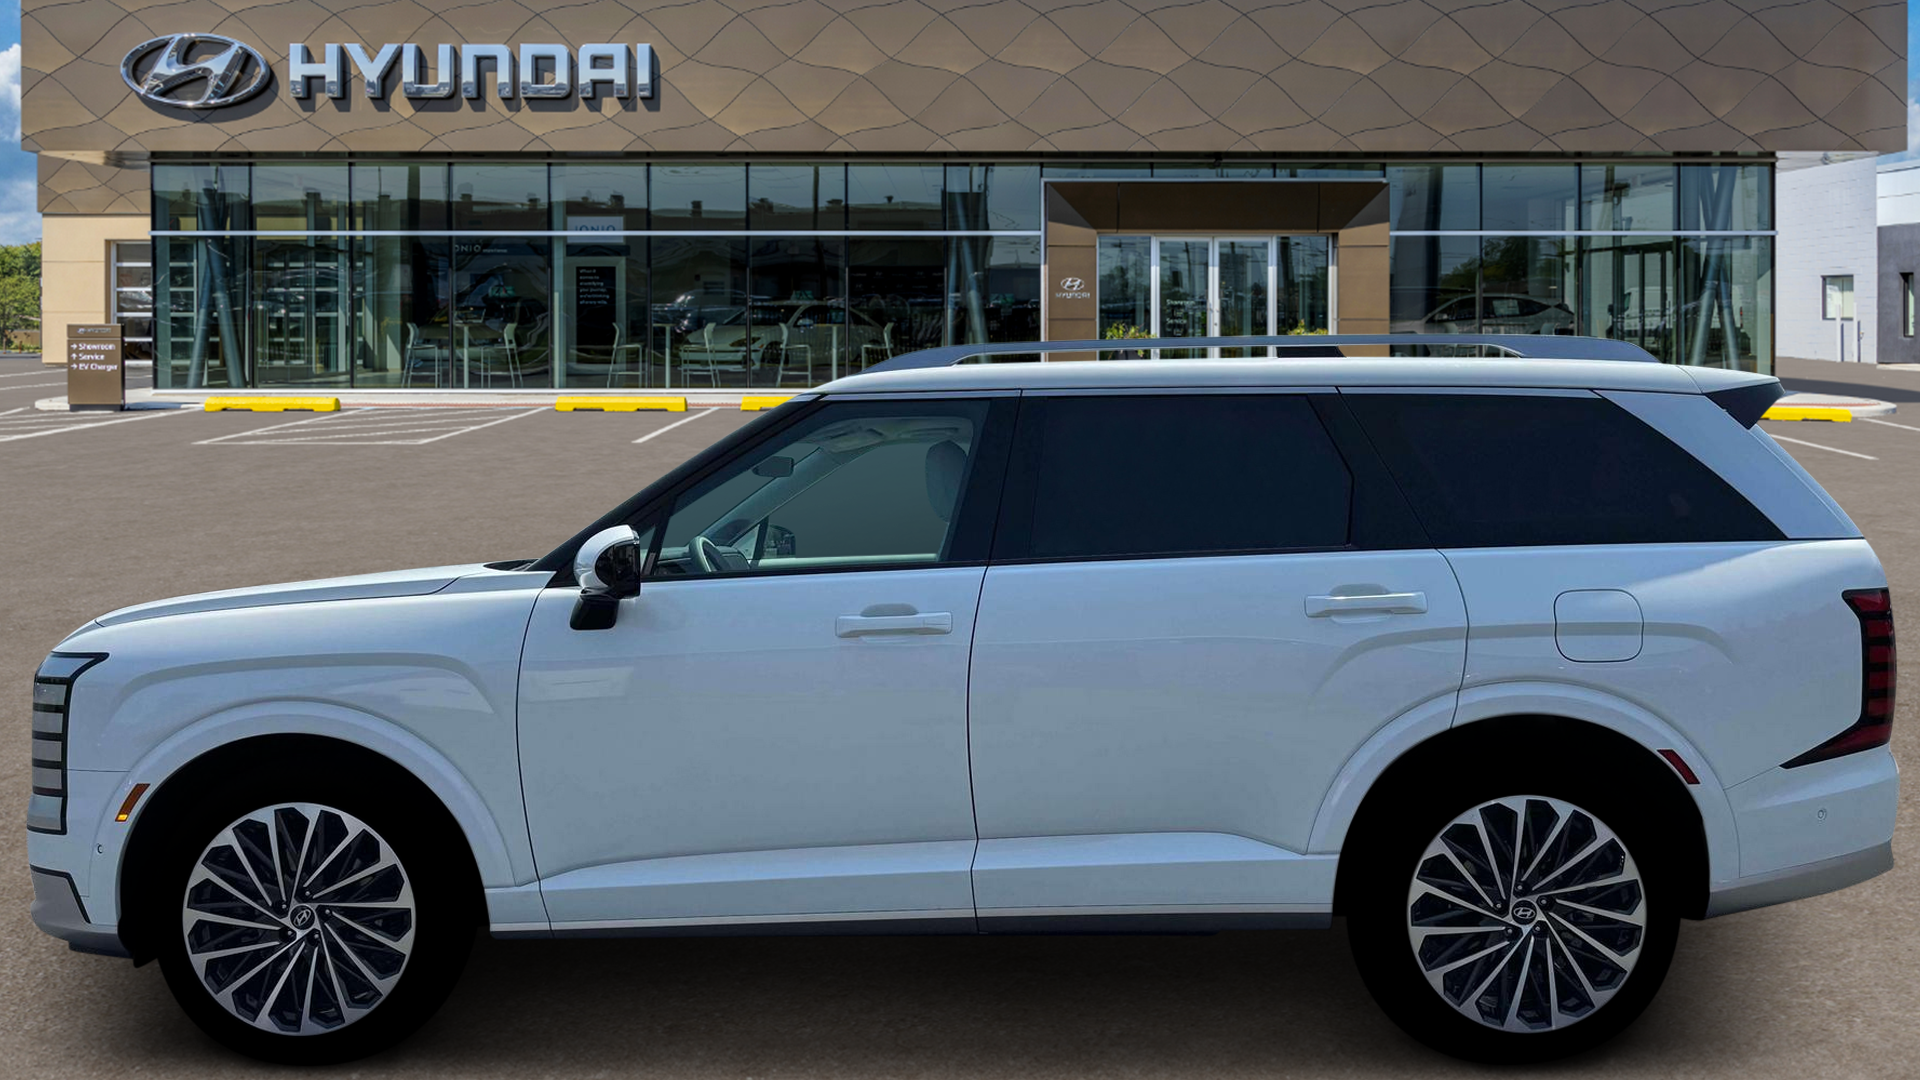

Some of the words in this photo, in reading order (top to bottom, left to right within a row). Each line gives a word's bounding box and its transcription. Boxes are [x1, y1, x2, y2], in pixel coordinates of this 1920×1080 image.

[289, 43, 655, 99] HYUNDAI
[78, 352, 105, 360] Service
[90, 363, 118, 371] Charger
